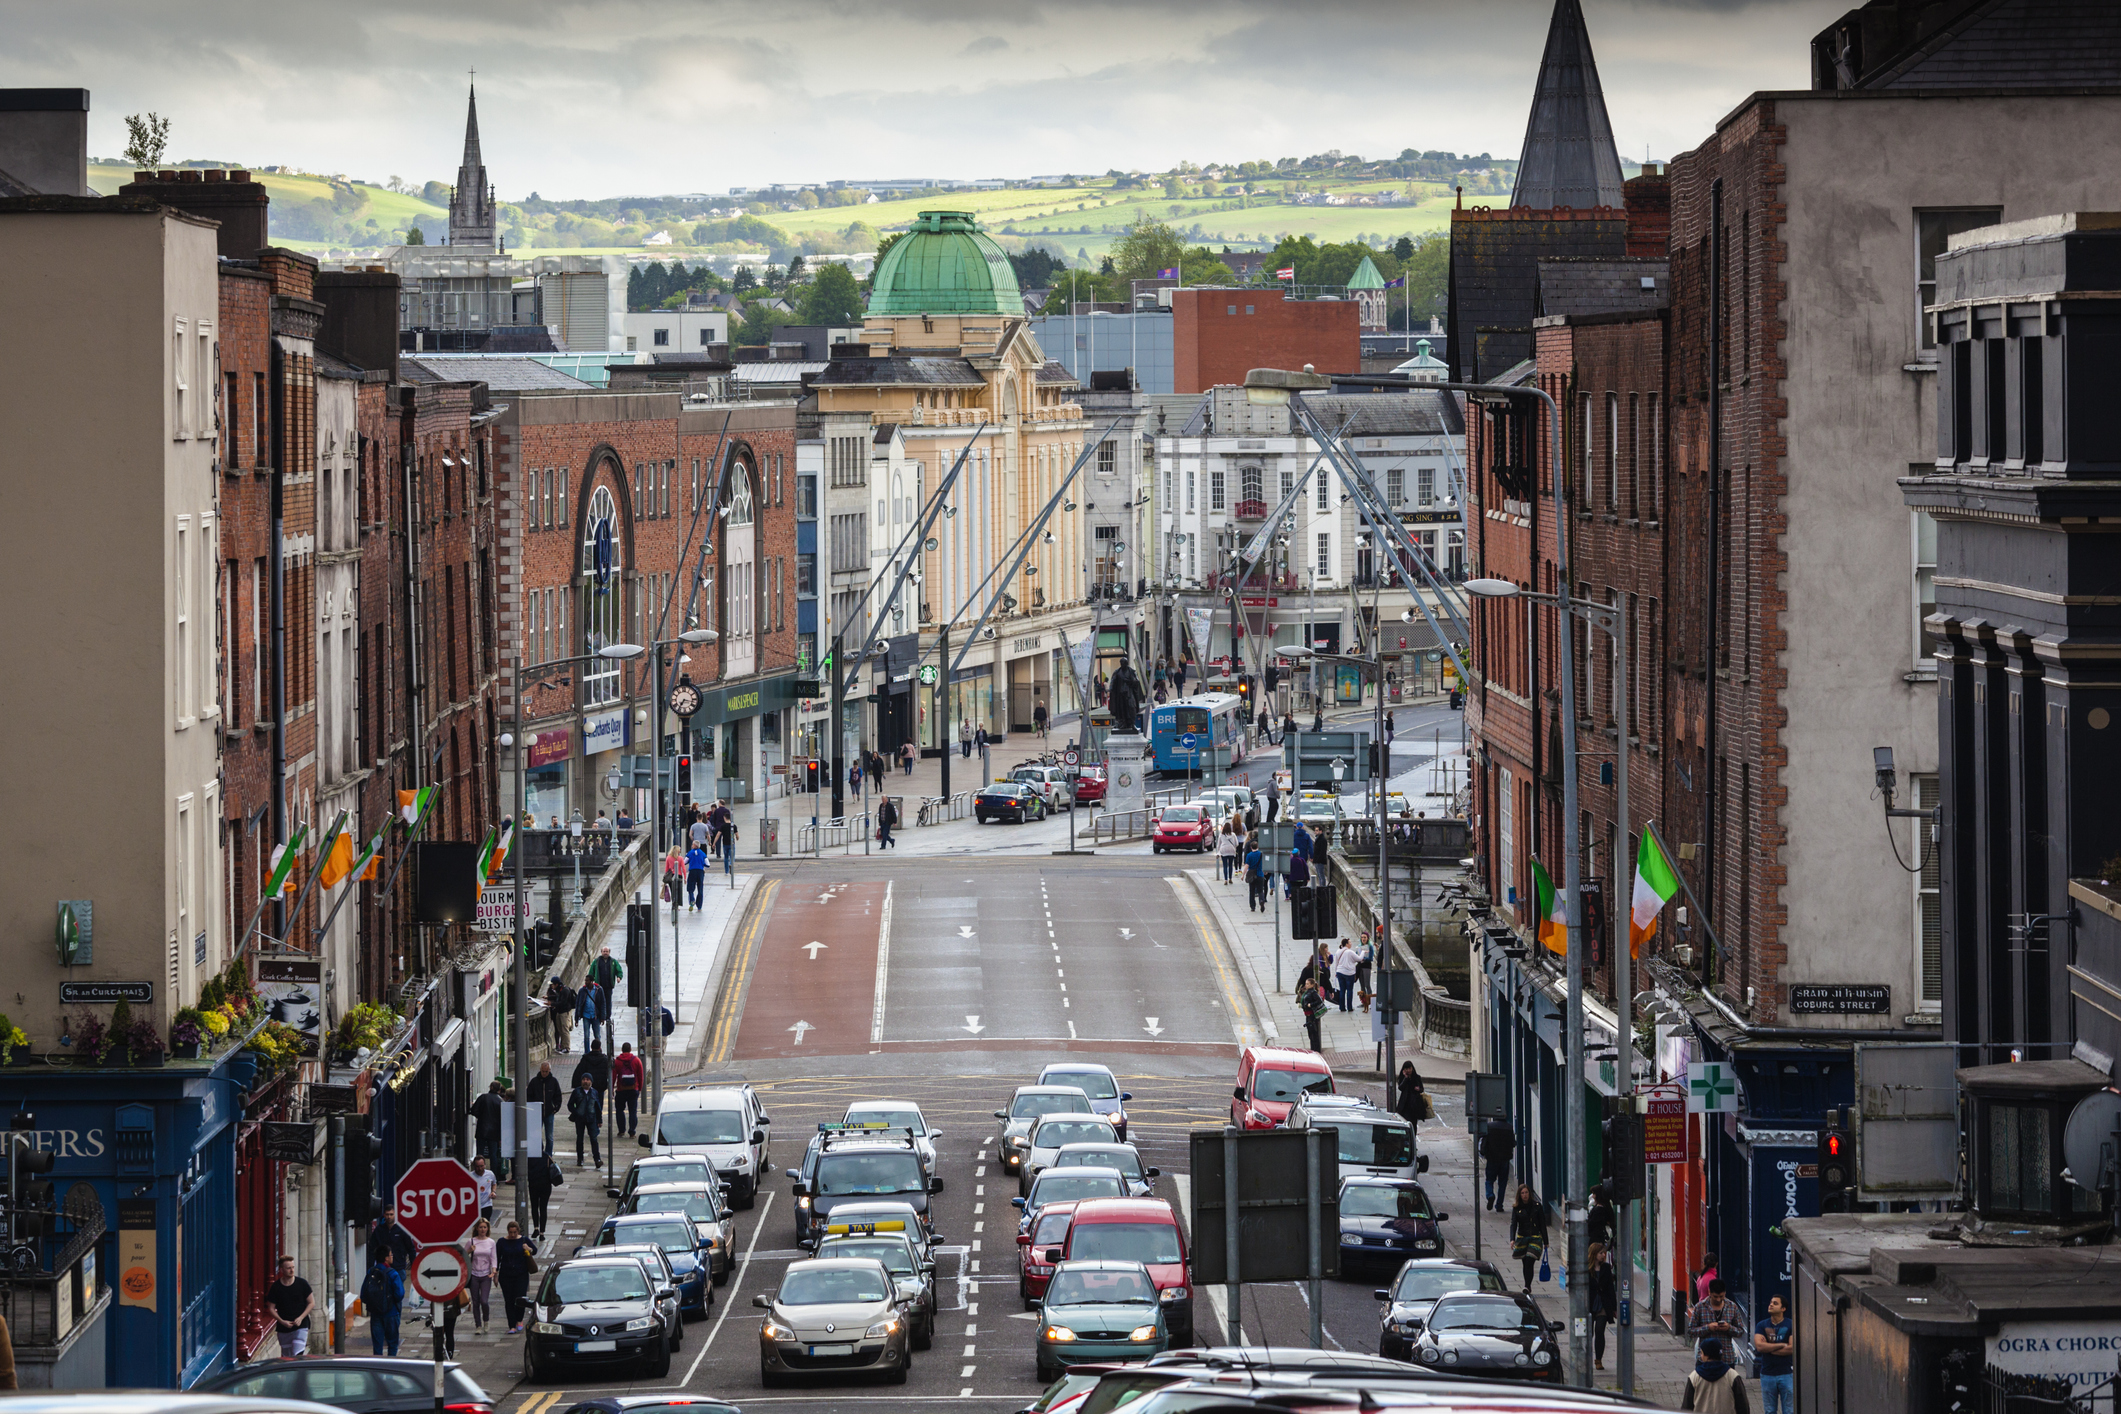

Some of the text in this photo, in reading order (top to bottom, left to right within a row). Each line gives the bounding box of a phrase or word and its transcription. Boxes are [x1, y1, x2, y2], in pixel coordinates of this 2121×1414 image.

[1415, 514, 1433, 522] SING
[797, 685, 817, 694] M&S
[611, 717, 621, 737] Quay
[476, 891, 529, 904] OURMT
[480, 917, 516, 930] BISTR
[1587, 894, 1599, 961] TATTOO
[295, 974, 317, 982] Roasters
[1796, 1001, 1877, 1010] COBURG STREET
[1657, 1104, 1683, 1113] HOUSE
[400, 1187, 476, 1218] STOP
[852, 1224, 872, 1232] TAXI
[1998, 1334, 2050, 1352] ÓGRA
